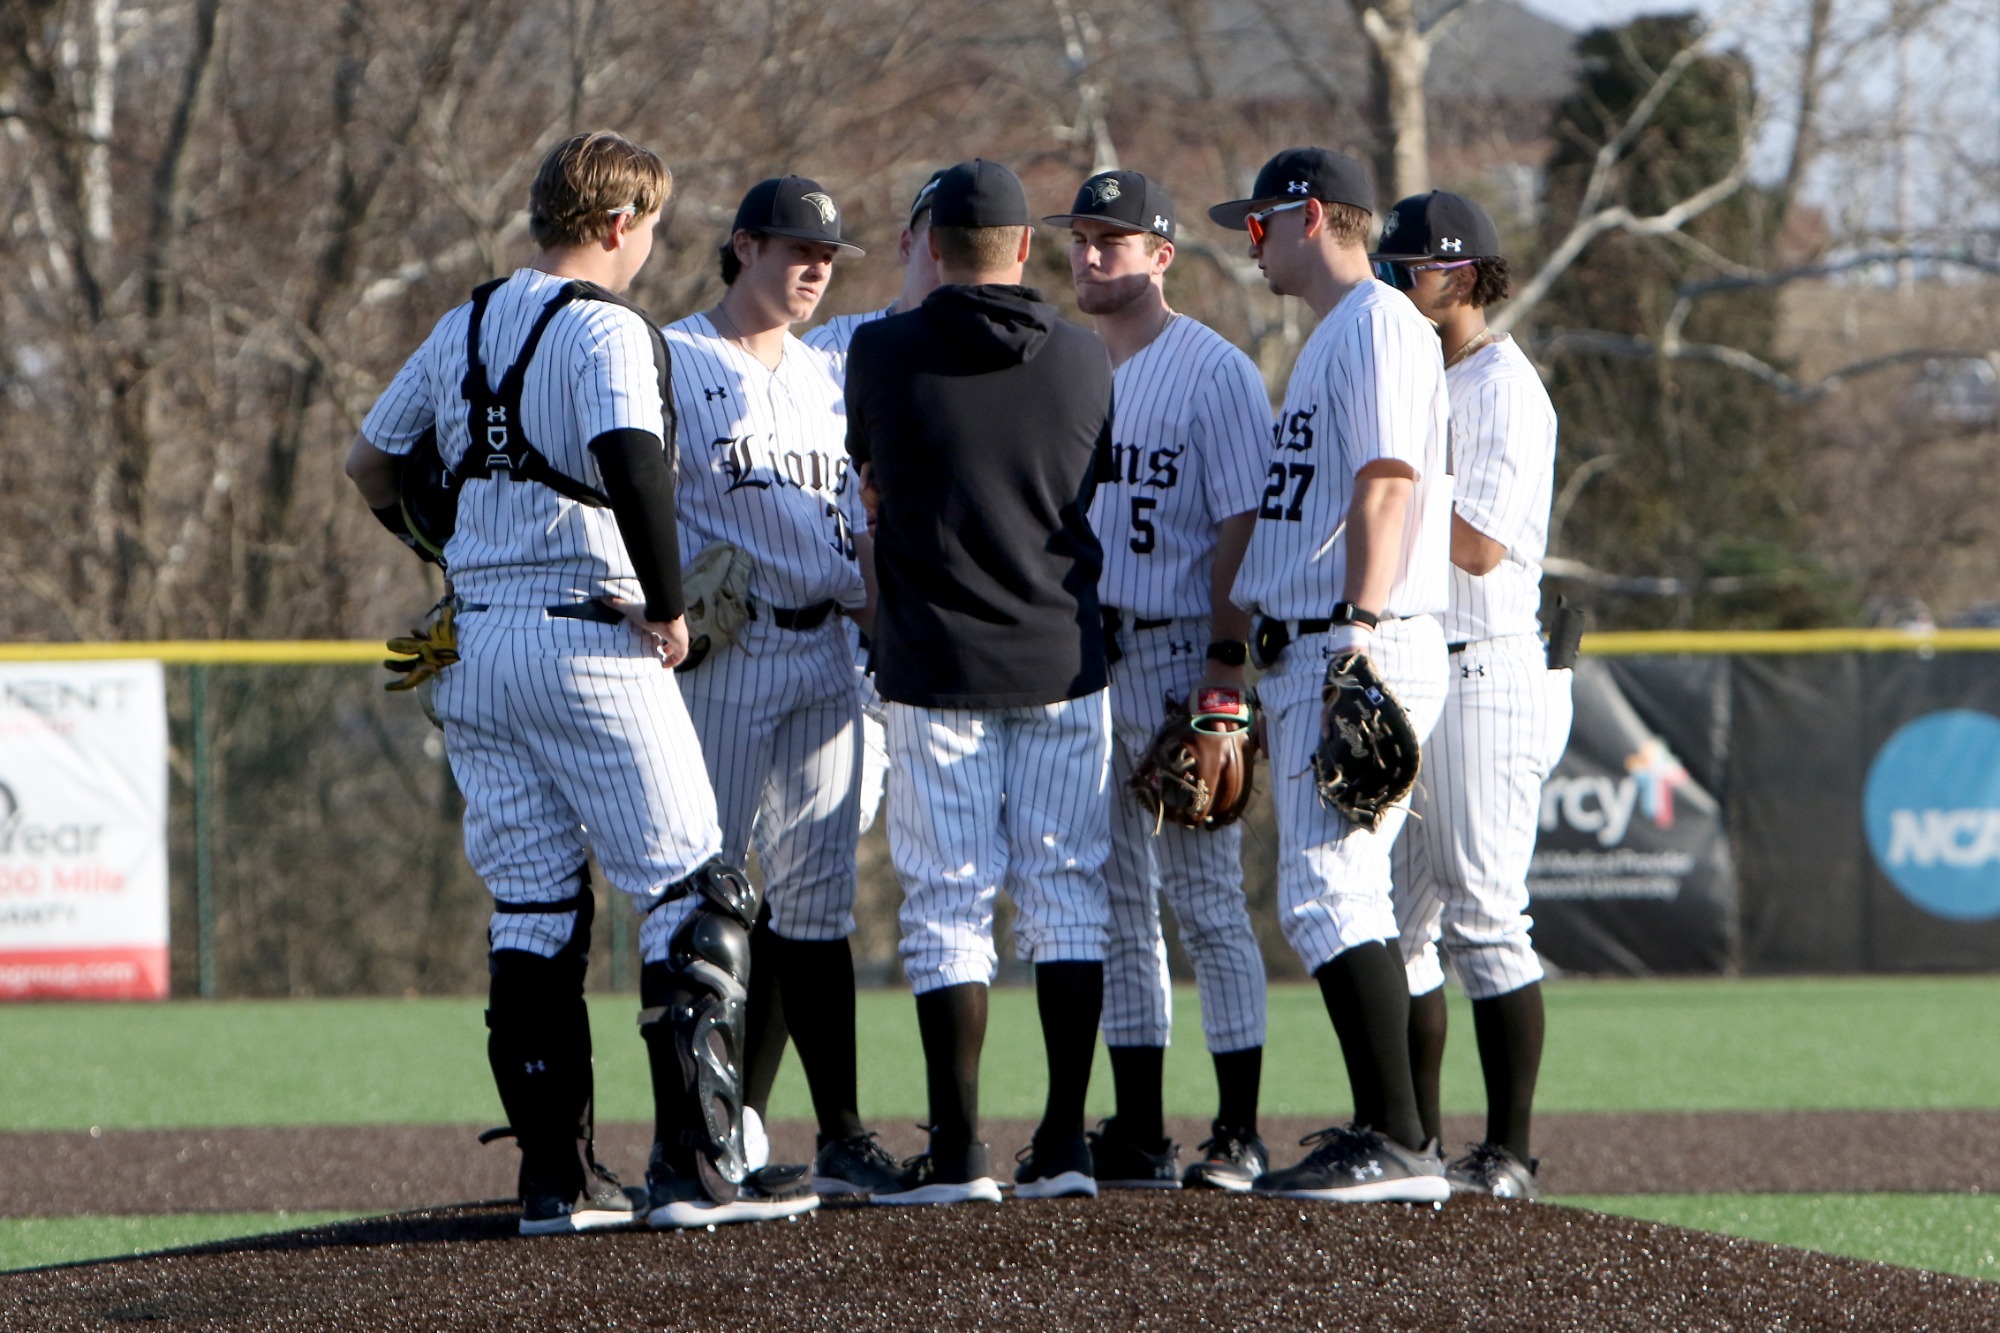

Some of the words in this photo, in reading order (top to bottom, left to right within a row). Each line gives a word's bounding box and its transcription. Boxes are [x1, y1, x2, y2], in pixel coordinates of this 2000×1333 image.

[711, 432, 851, 495] Lions
[1258, 461, 1315, 521] 27
[1129, 496, 1157, 554] 5
